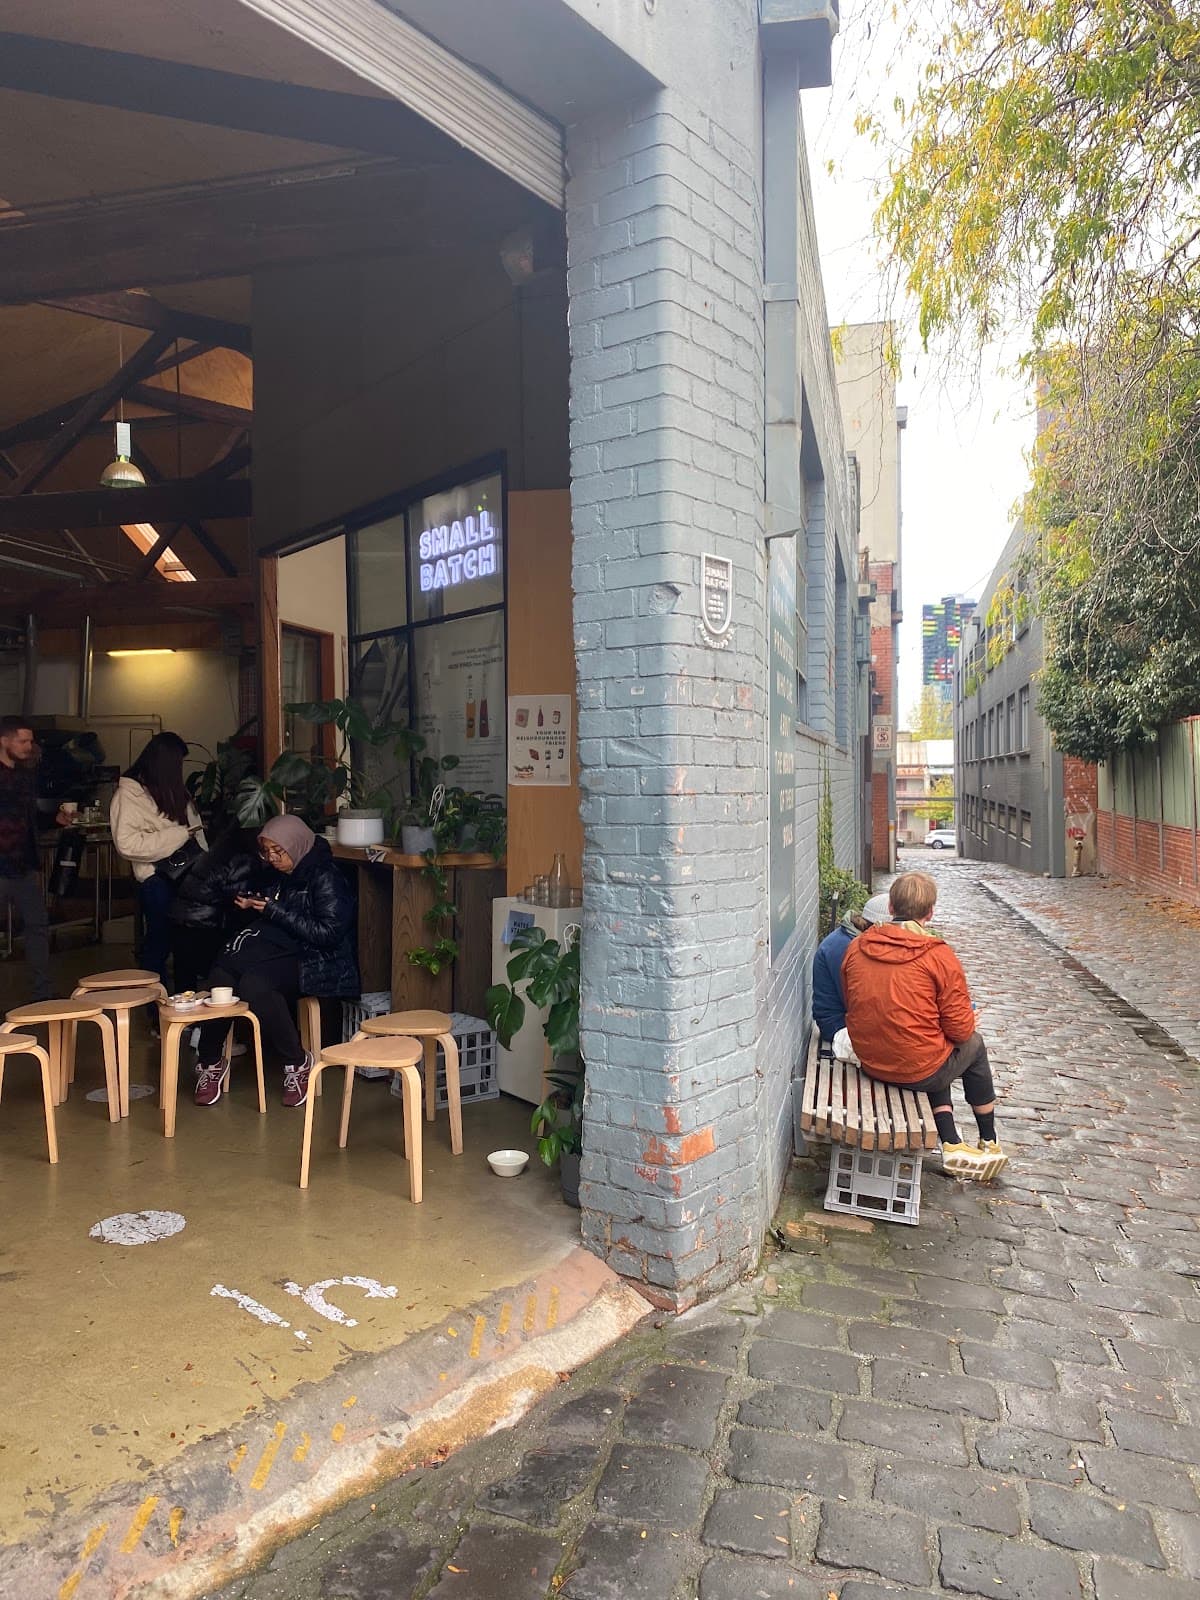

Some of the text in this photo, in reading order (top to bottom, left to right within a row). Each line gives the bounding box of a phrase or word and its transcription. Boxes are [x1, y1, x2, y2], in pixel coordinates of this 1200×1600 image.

[420, 510, 493, 559] SMALL
[420, 544, 495, 592] BATCH
[705, 566, 727, 581] SMALL
[705, 576, 729, 590] BATCH
